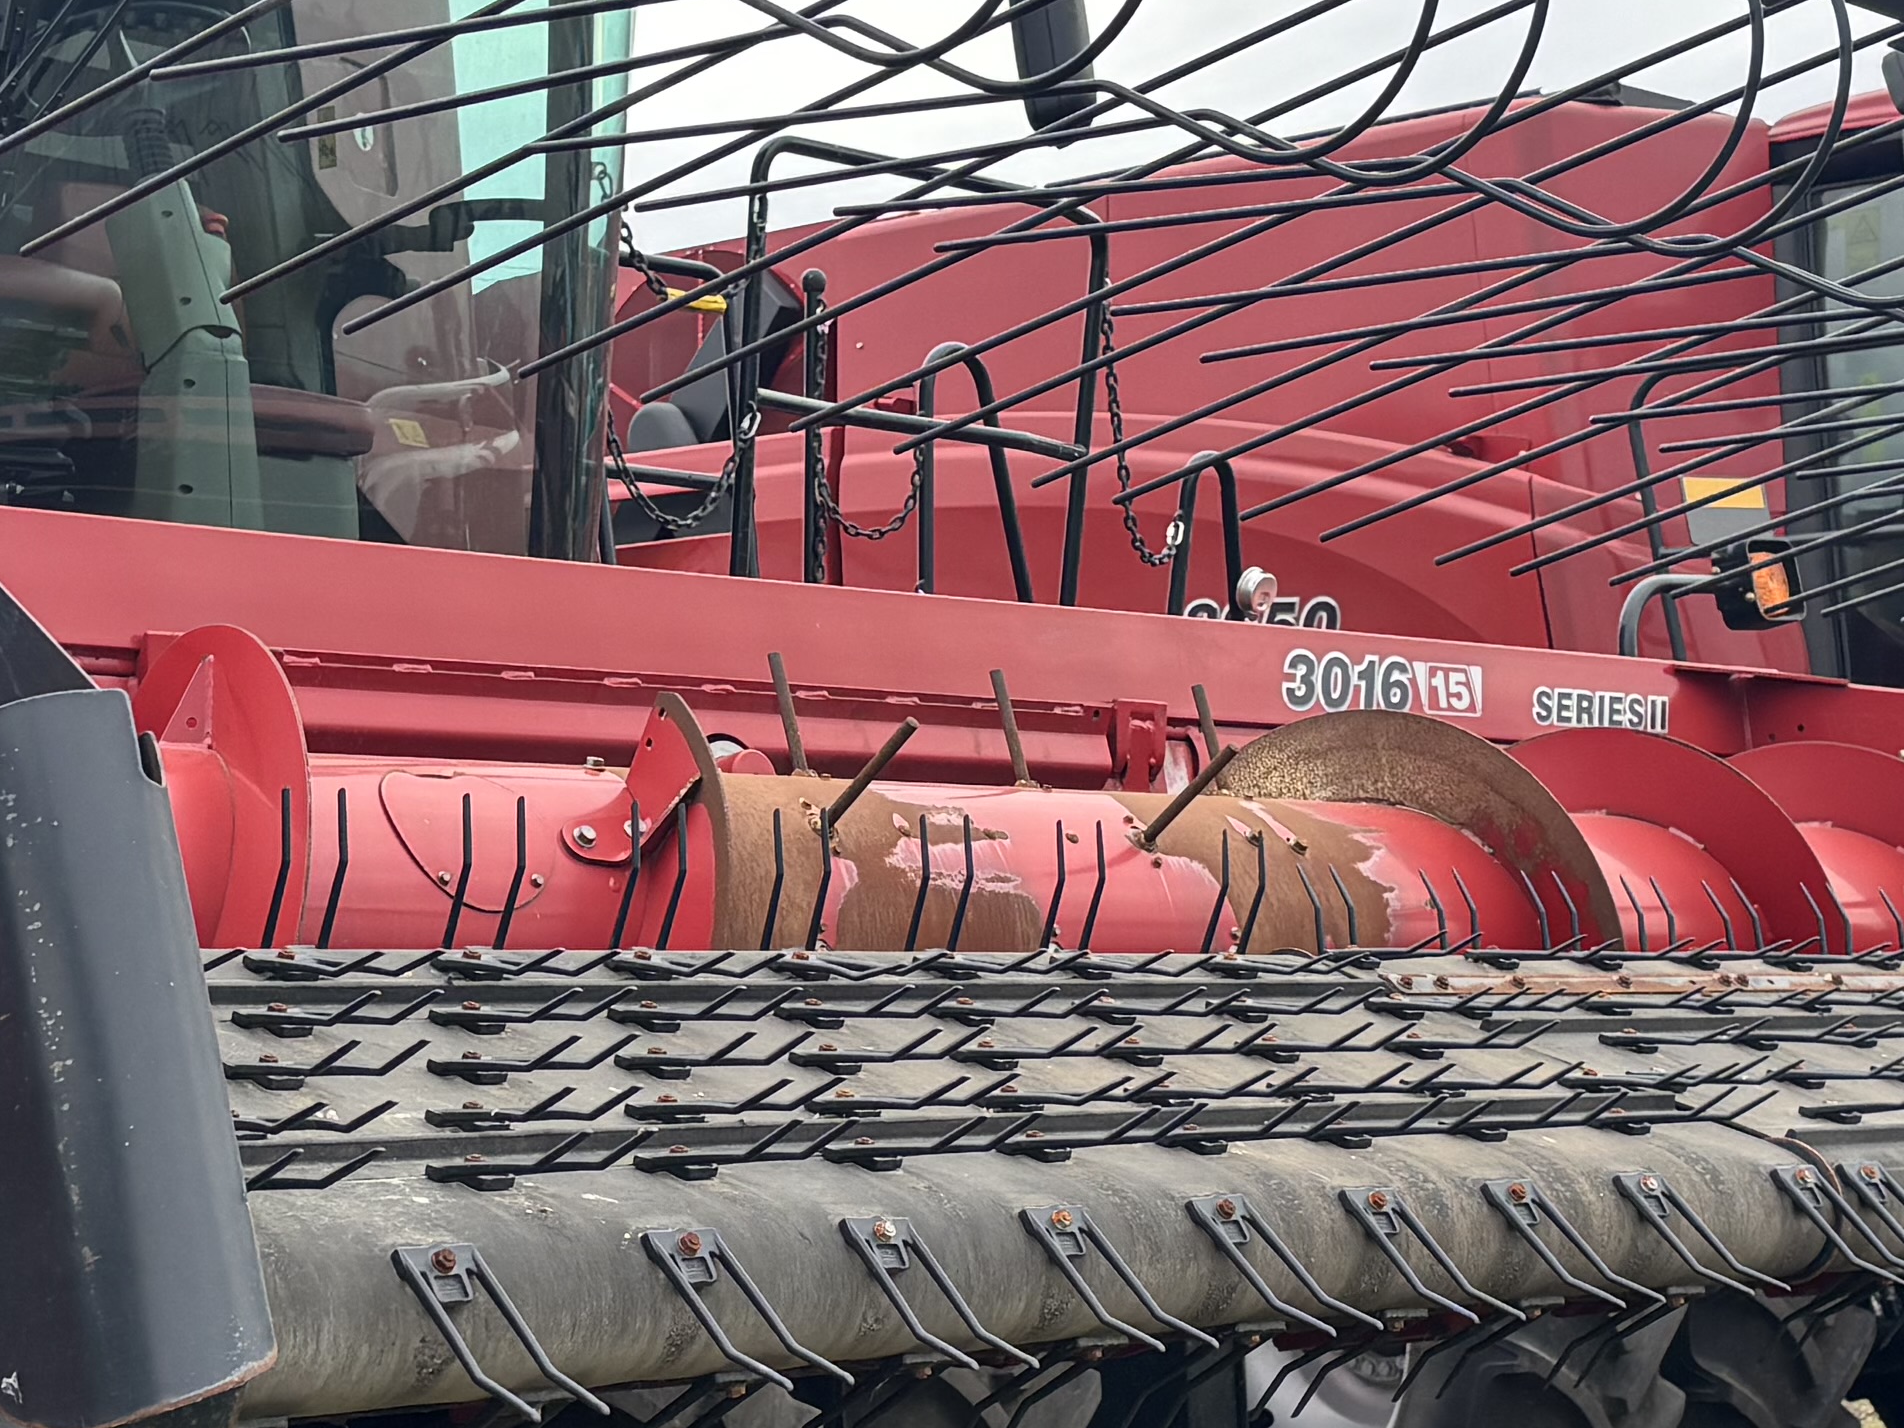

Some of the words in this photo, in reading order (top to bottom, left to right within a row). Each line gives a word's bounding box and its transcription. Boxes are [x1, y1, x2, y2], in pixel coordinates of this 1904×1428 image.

[1283, 649, 1412, 713] 3016
[1431, 670, 1471, 710] 15
[1532, 686, 1645, 730] SERIES
[1648, 695, 1669, 733] II
